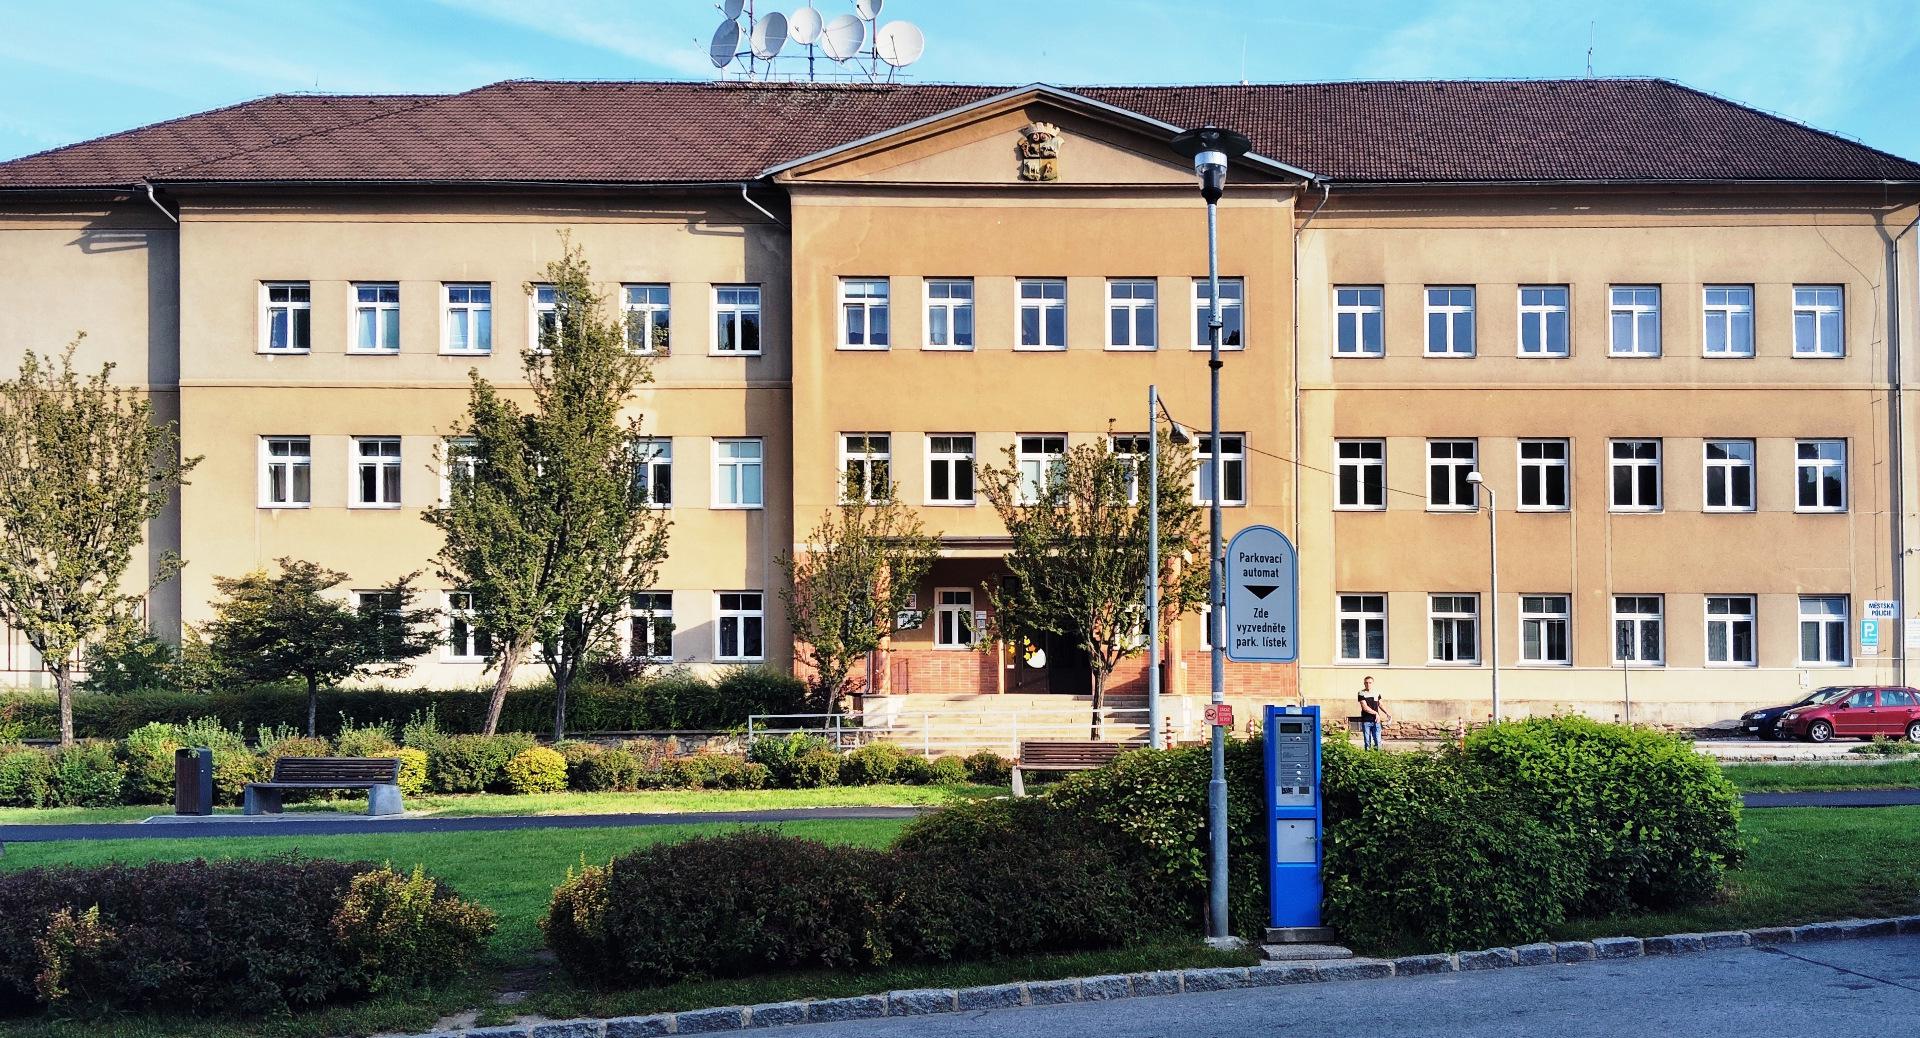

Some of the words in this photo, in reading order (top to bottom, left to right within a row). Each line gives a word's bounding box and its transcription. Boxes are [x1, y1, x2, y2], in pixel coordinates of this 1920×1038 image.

[1239, 552, 1282, 564] Parkovací
[1243, 568, 1279, 578] automat
[1253, 607, 1269, 618] Zde
[1236, 622, 1286, 634] vyzvedněte
[1864, 622, 1875, 637] P
[1236, 637, 1259, 649] park.
[1262, 637, 1287, 648] lístek
